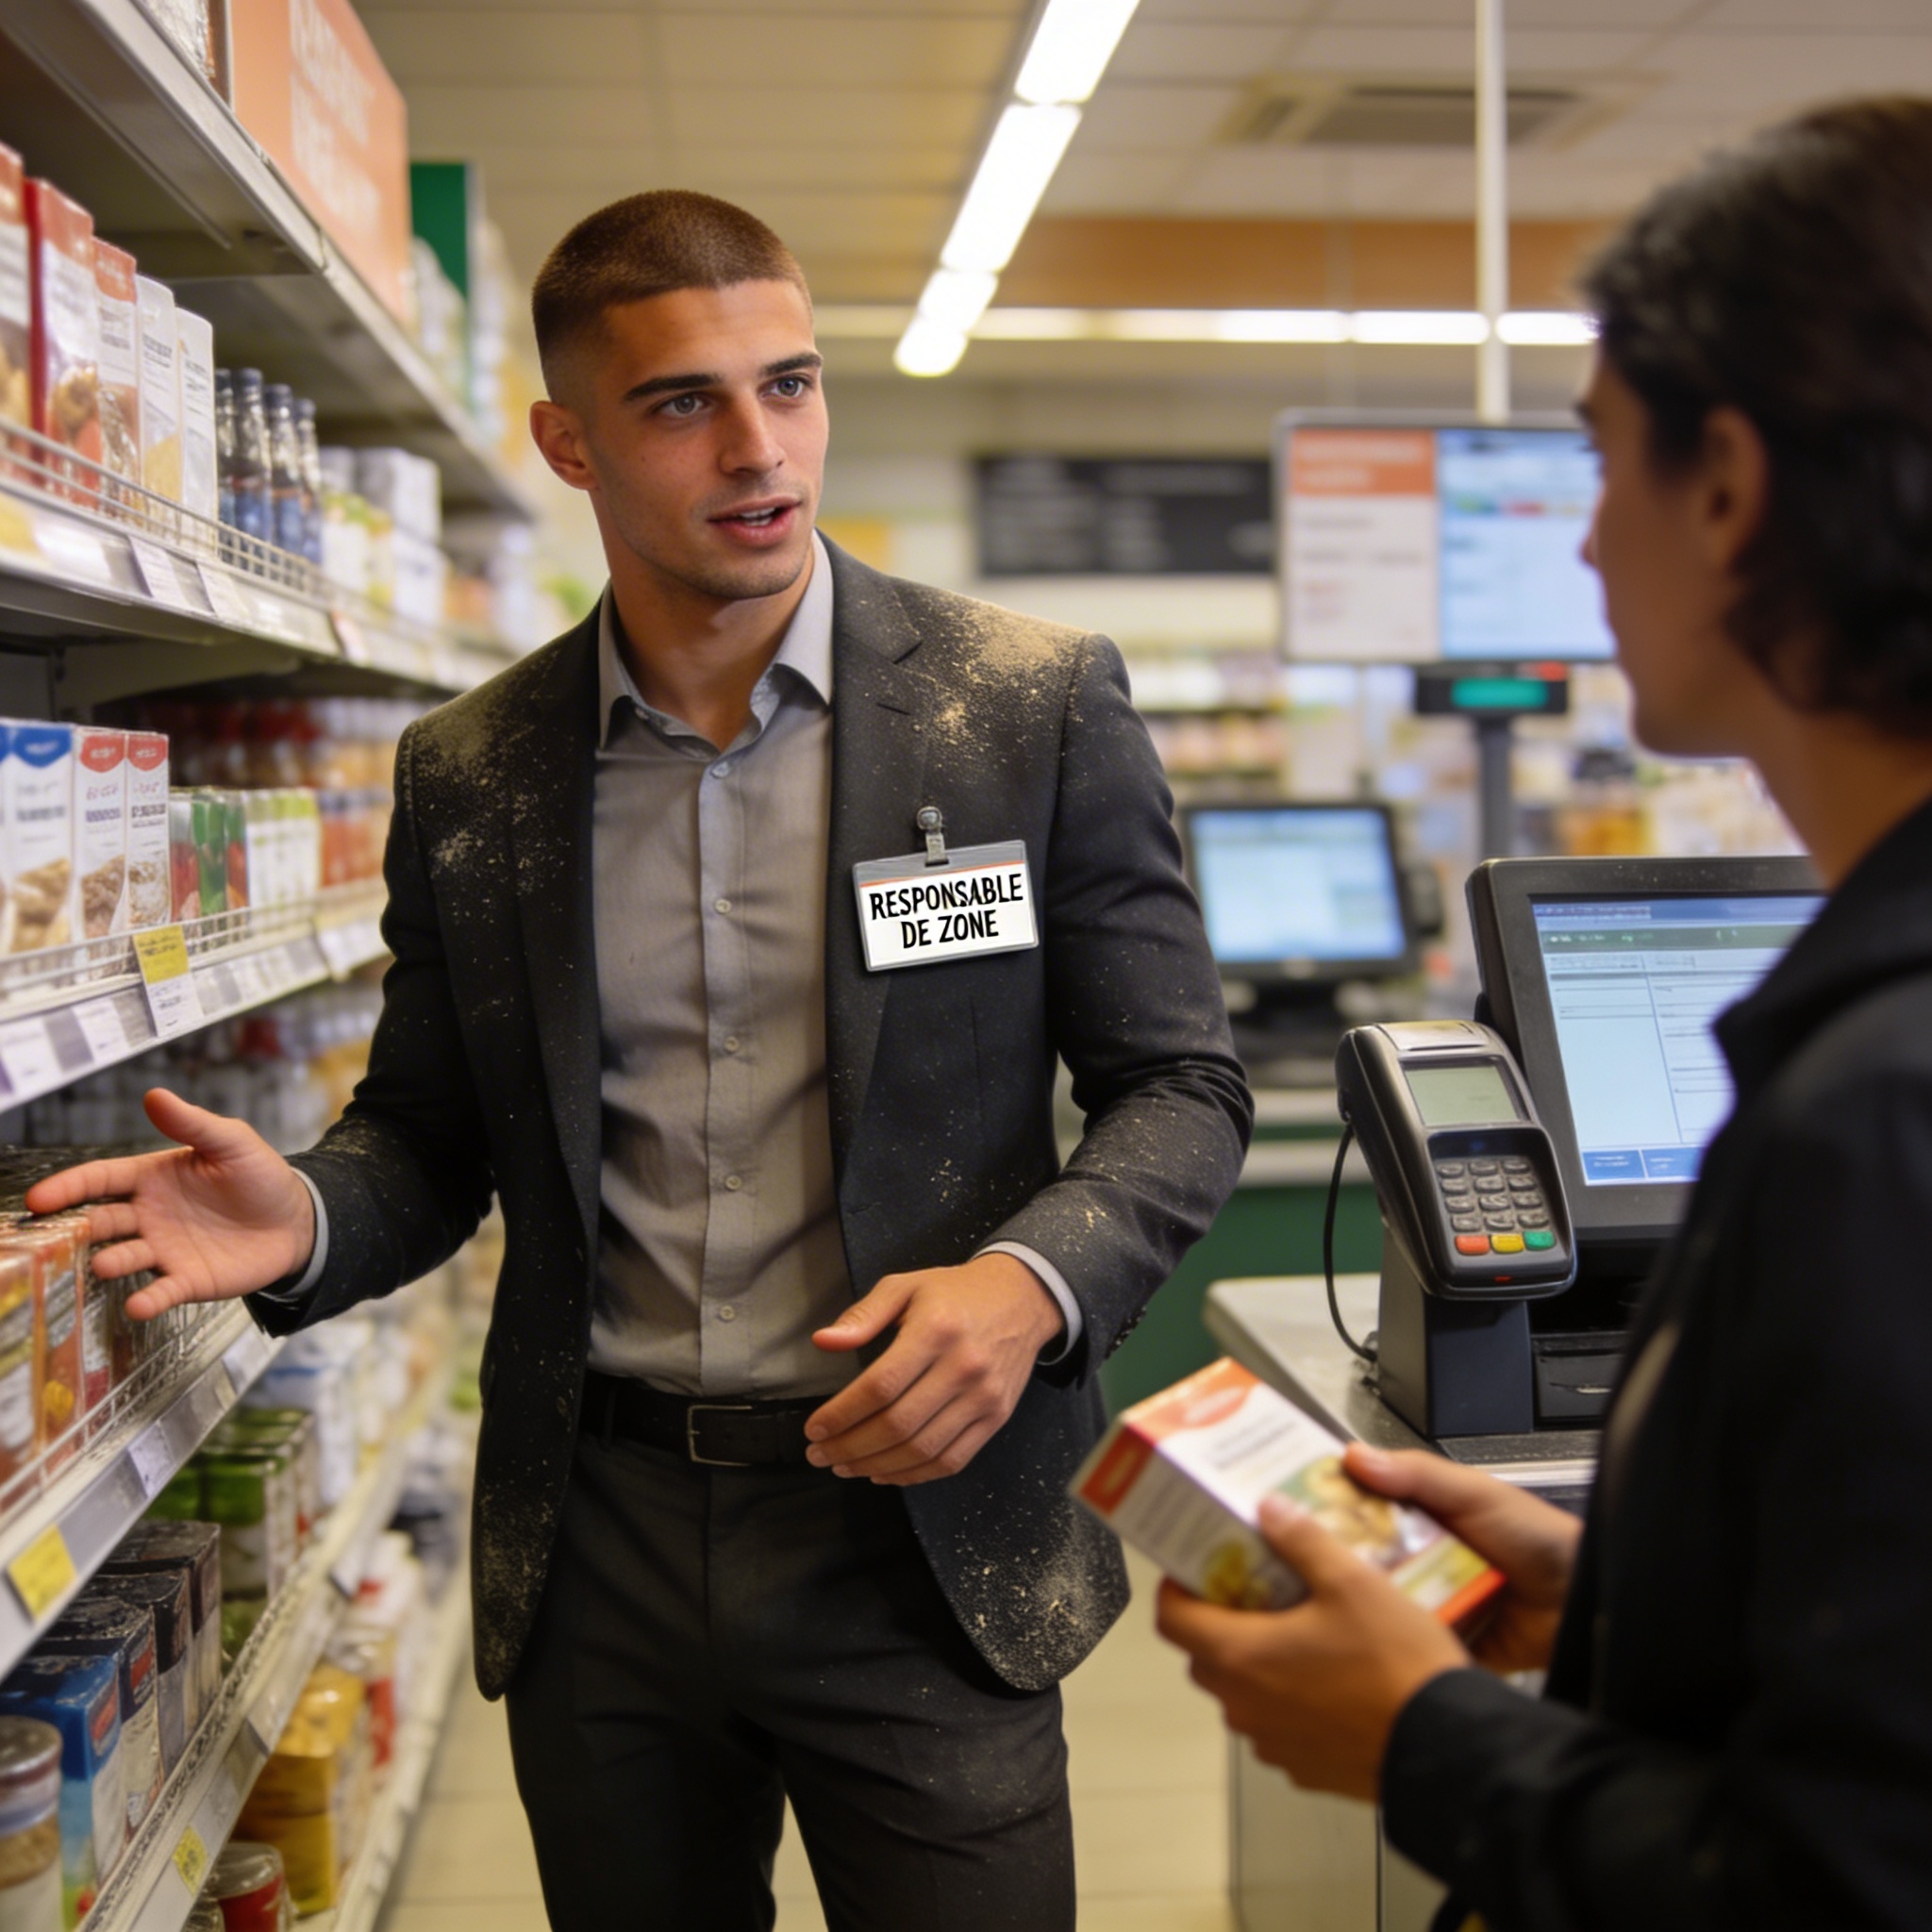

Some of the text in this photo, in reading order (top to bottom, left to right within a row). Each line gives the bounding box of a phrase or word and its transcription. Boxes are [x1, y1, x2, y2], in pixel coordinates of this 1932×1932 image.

[870, 874, 1024, 920] RESPONSABLE
[902, 909, 999, 948] DE ZONE
